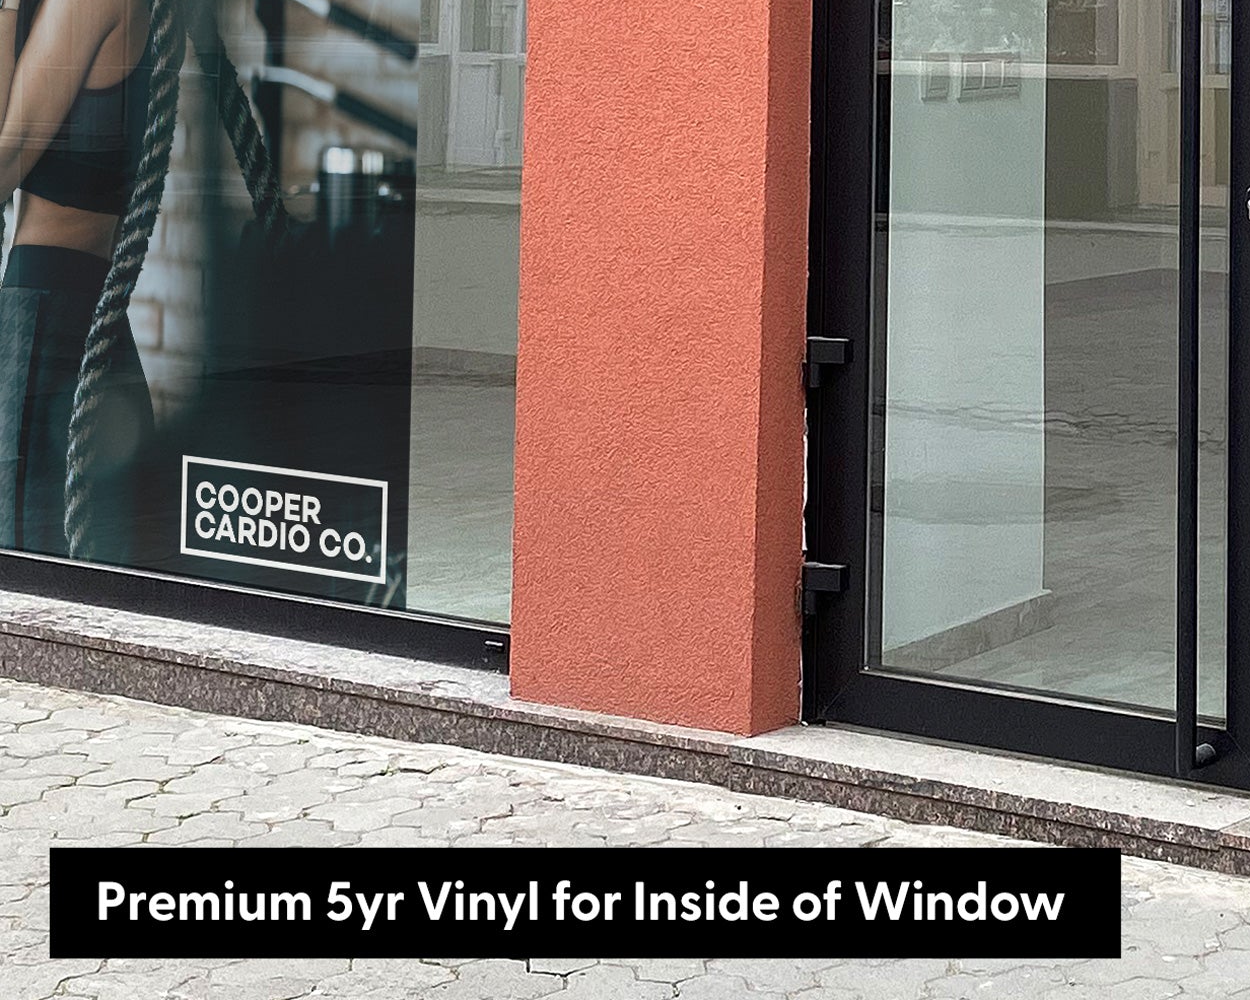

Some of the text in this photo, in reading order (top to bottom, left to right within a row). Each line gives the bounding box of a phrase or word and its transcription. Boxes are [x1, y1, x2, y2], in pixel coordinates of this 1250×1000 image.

[195, 481, 321, 524] COOPER
[194, 511, 372, 564] CARDIO CO.
